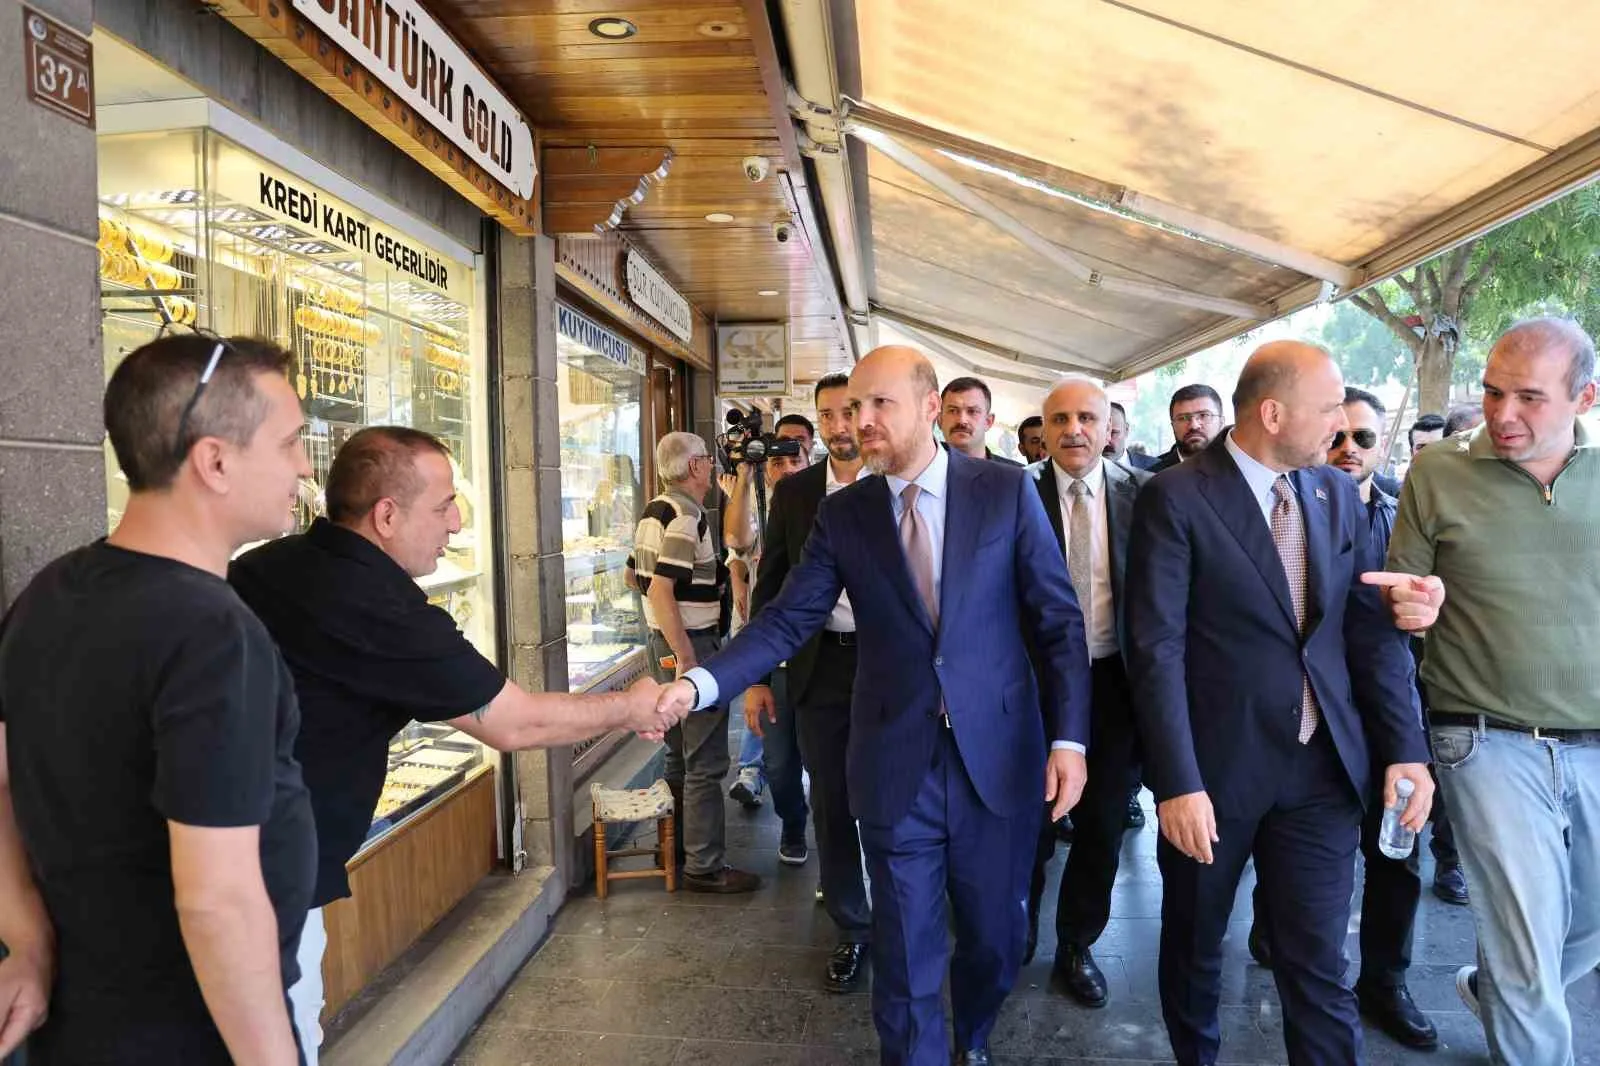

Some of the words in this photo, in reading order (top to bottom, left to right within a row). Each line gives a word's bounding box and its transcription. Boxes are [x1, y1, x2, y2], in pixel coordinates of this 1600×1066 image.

[40, 54, 73, 99] 37
[77, 71, 88, 95] A
[316, 0, 454, 122] NTÜRK
[462, 83, 512, 174] GOLD
[260, 172, 318, 229] KREDİ
[323, 204, 371, 253] KARTI
[374, 232, 448, 290] GEÇERLİDİR
[559, 306, 628, 365] KUYUMCUSU
